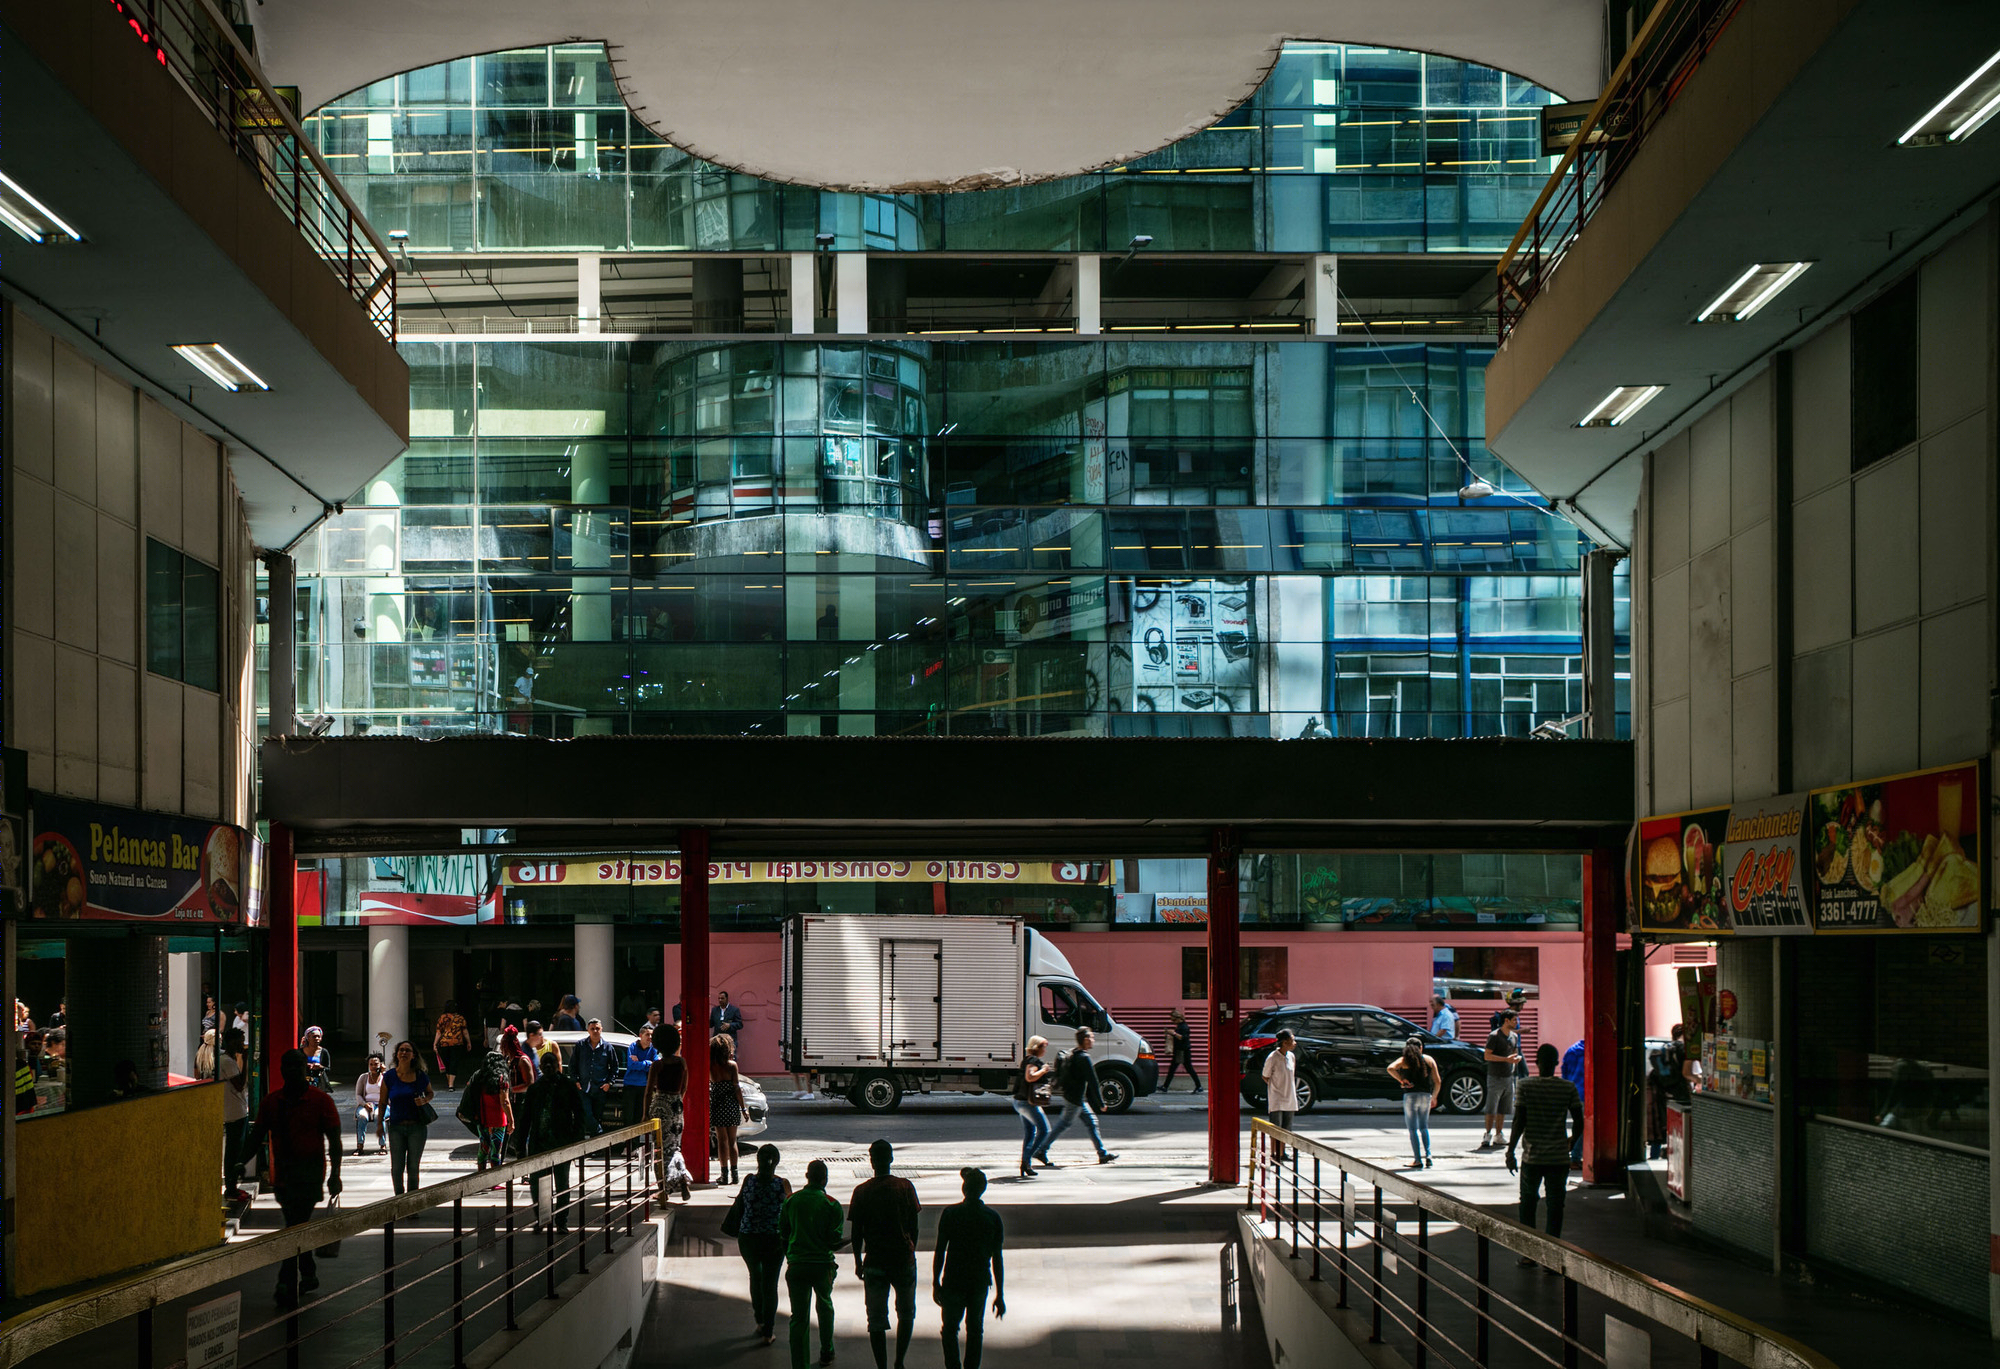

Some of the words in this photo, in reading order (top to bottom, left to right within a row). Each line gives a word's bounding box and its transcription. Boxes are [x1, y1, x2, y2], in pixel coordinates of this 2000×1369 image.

[1726, 807, 1801, 843] Lanchonete
[89, 823, 167, 868] Pelancas
[171, 833, 200, 871] Bar
[89, 870, 107, 885] Suco
[108, 872, 135, 887] Natural
[136, 877, 144, 887] na
[146, 875, 167, 889] Caneca
[1732, 845, 1796, 912] City
[174, 907, 185, 919] Loja
[1820, 900, 1878, 922] 3361-4777
